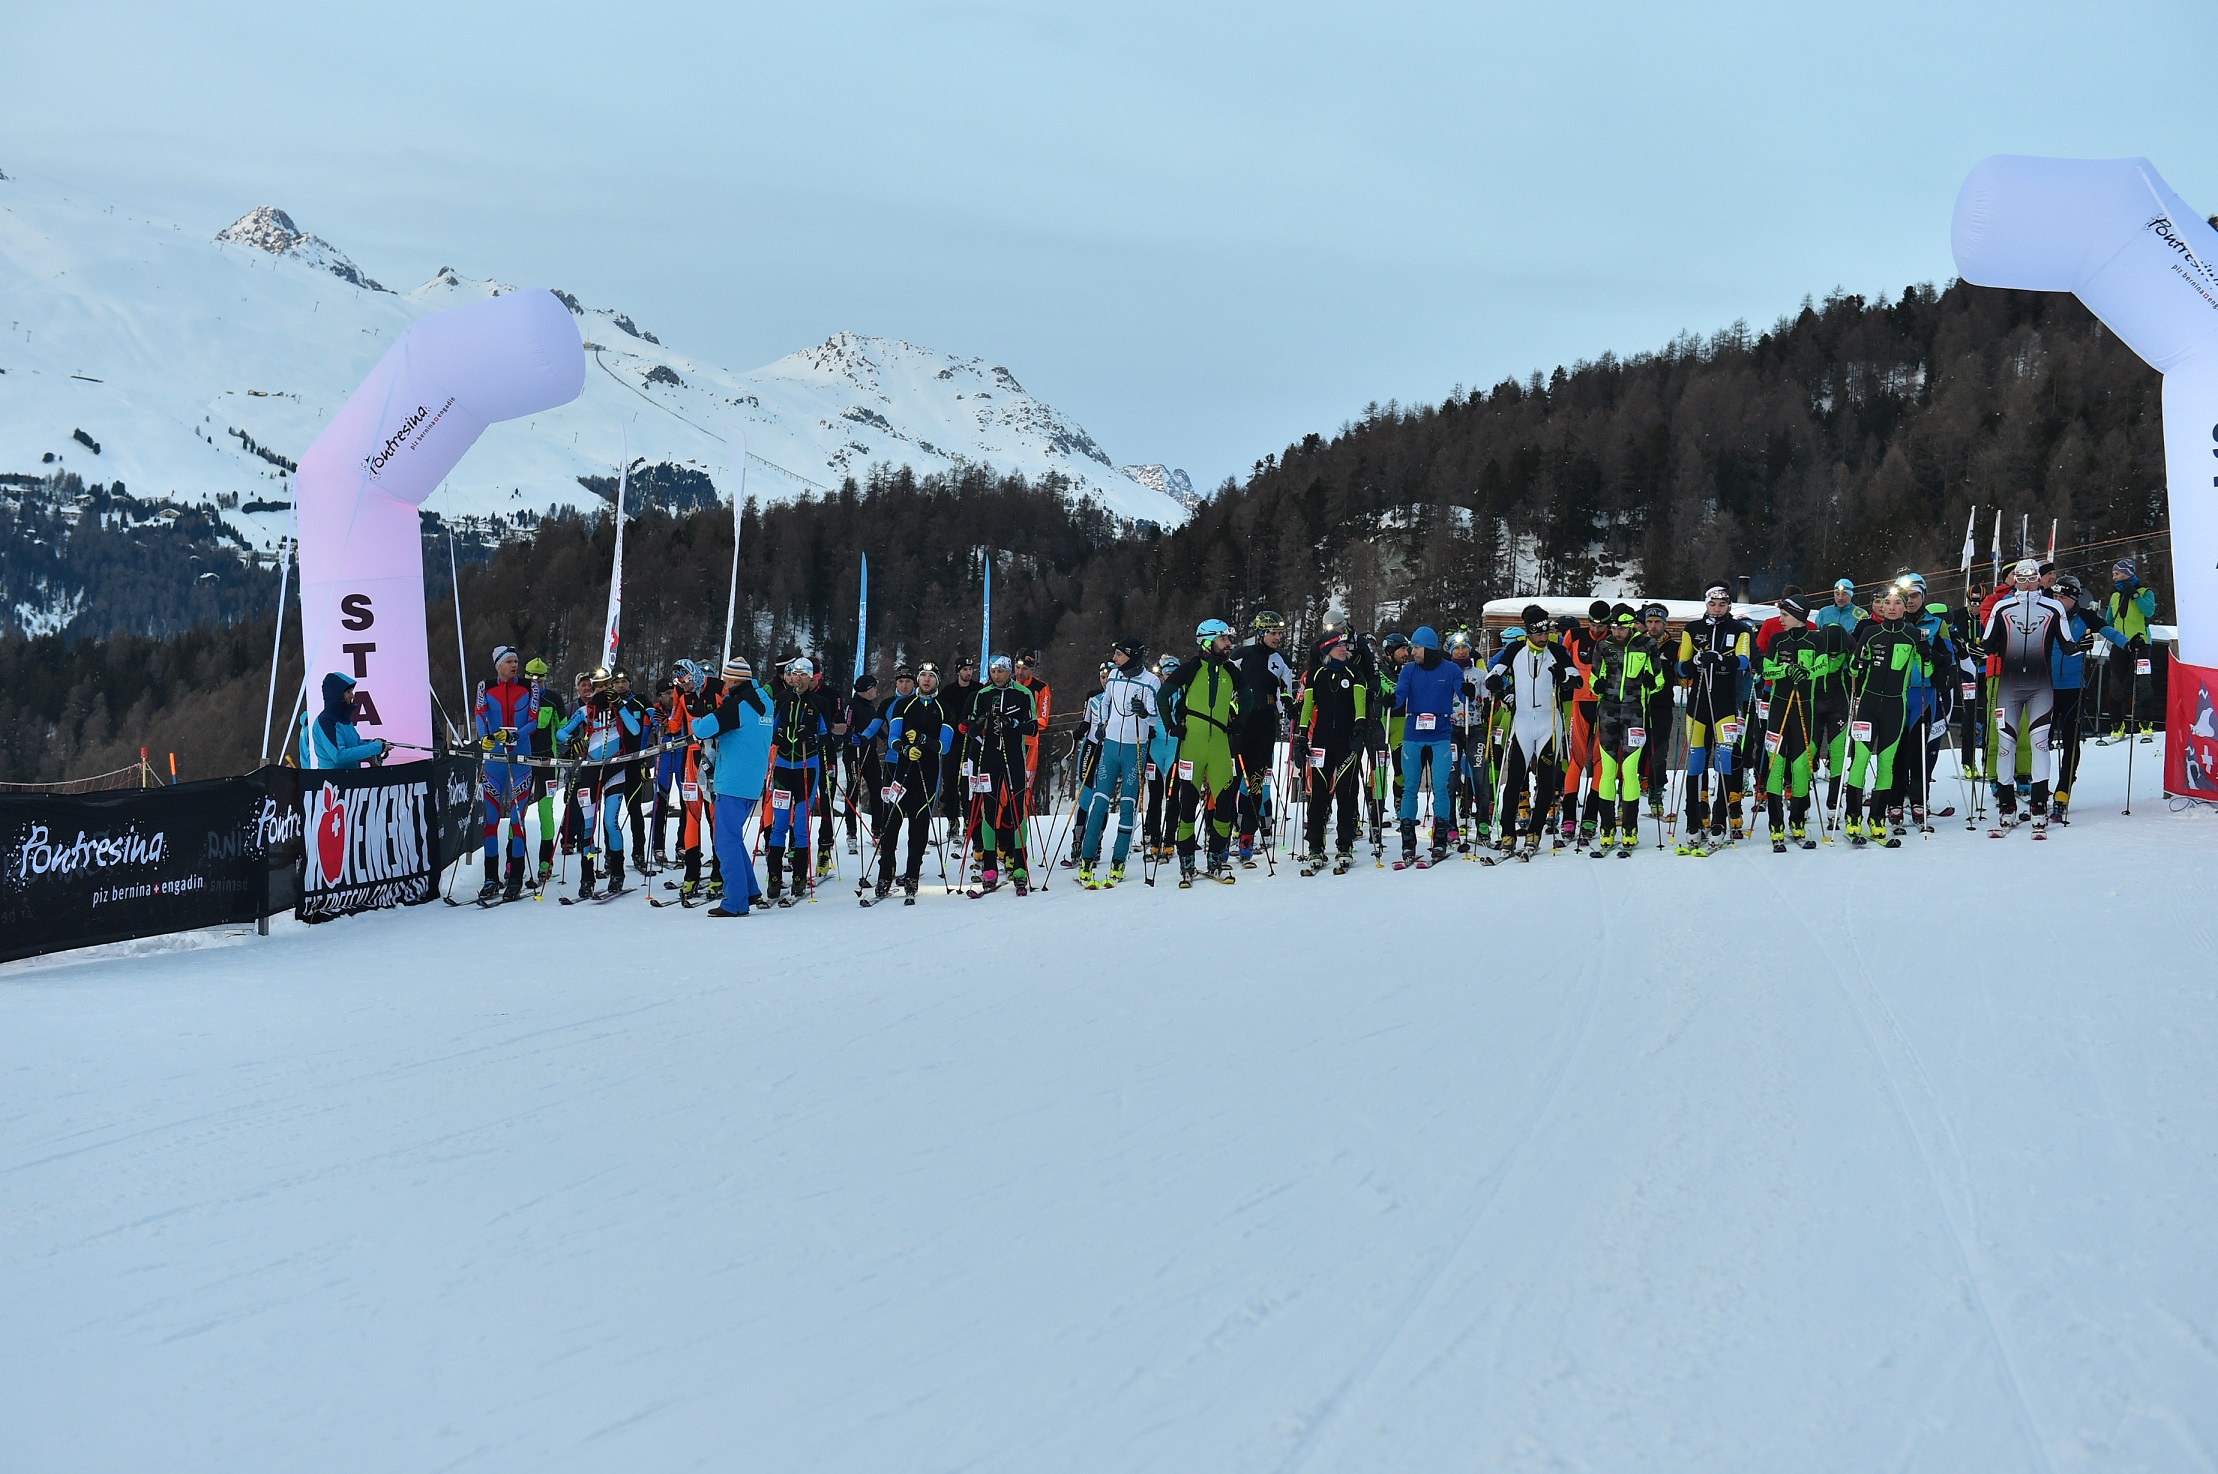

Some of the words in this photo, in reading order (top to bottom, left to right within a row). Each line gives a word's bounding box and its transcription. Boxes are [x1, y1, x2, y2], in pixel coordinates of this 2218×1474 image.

[1473, 742, 1486, 768] kelag
[256, 798, 300, 848] Pontre
[303, 780, 431, 892] MOVEMENT
[20, 824, 164, 878] Pontresina
[92, 887, 108, 908] piz
[112, 882, 151, 902] bernina
[161, 874, 204, 896] engadin
